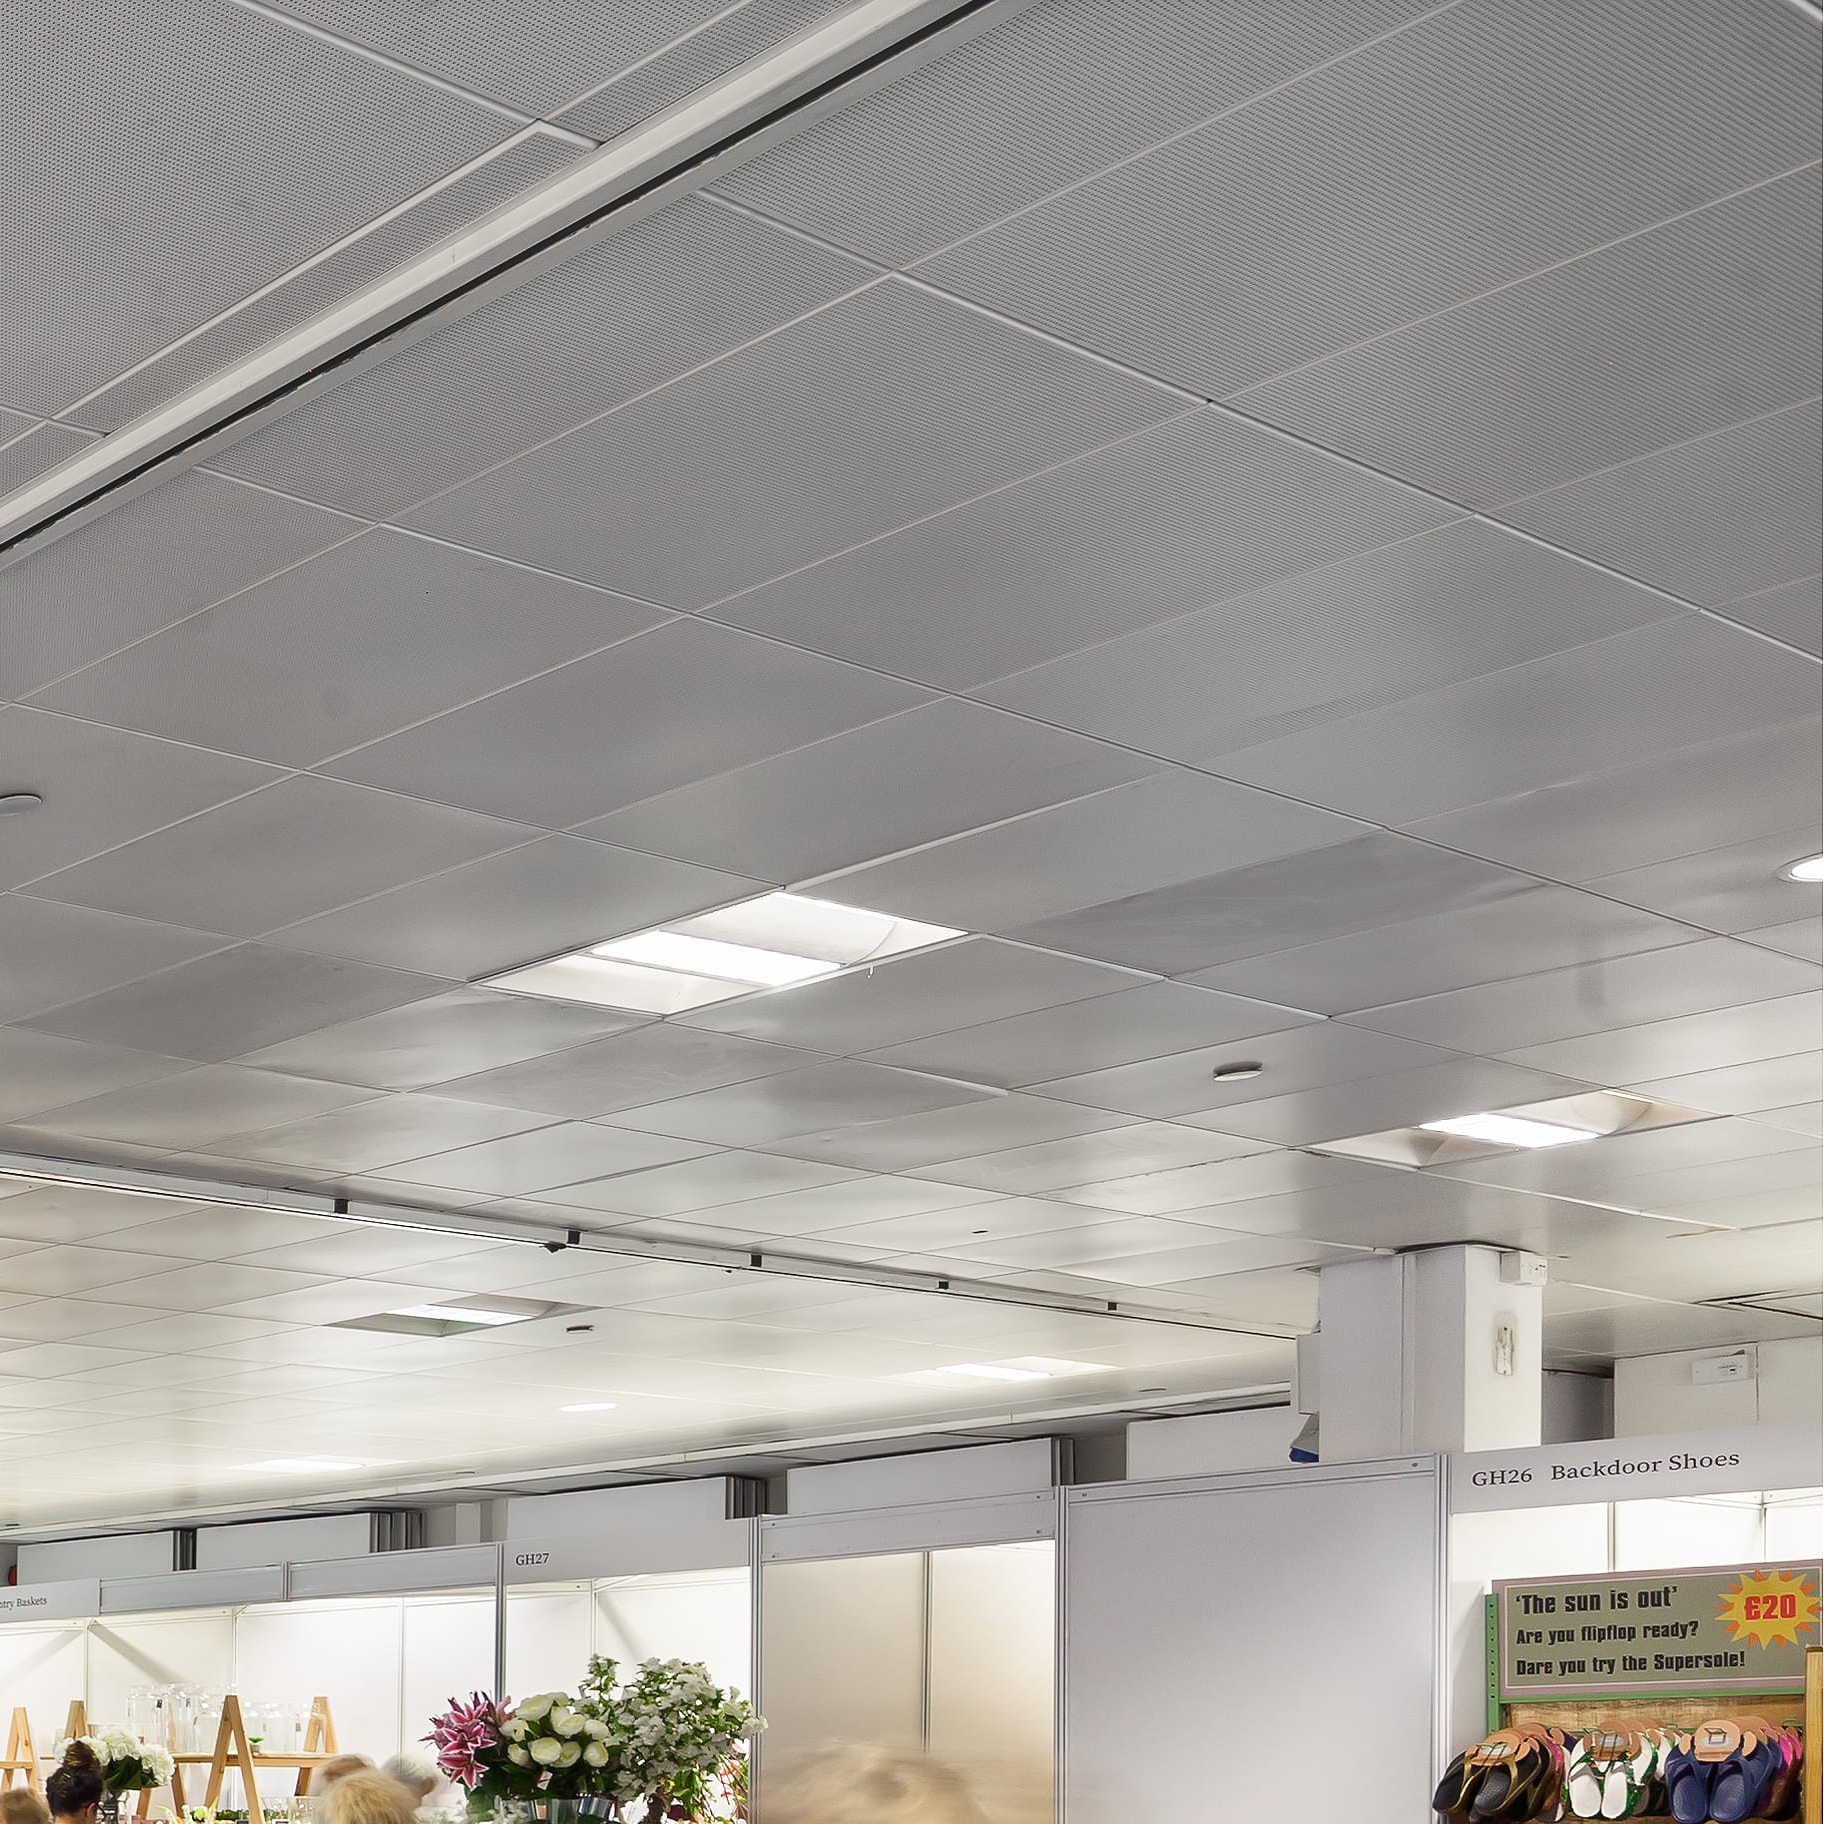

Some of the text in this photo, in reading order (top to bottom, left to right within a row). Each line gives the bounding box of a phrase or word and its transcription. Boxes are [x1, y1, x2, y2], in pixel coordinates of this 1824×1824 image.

[1472, 1453, 1740, 1487] GH26 Backdoor Shoes
[516, 1553, 549, 1566] GH27
[16, 1596, 48, 1608] Baskets
[1564, 1593, 1601, 1613] sun
[1610, 1589, 1629, 1610] is
[1744, 1593, 1797, 1621] £20
[1516, 1620, 1699, 1646] Are you flipflop ready?
[1516, 1651, 1745, 1677] Dare you try the Supersole!
